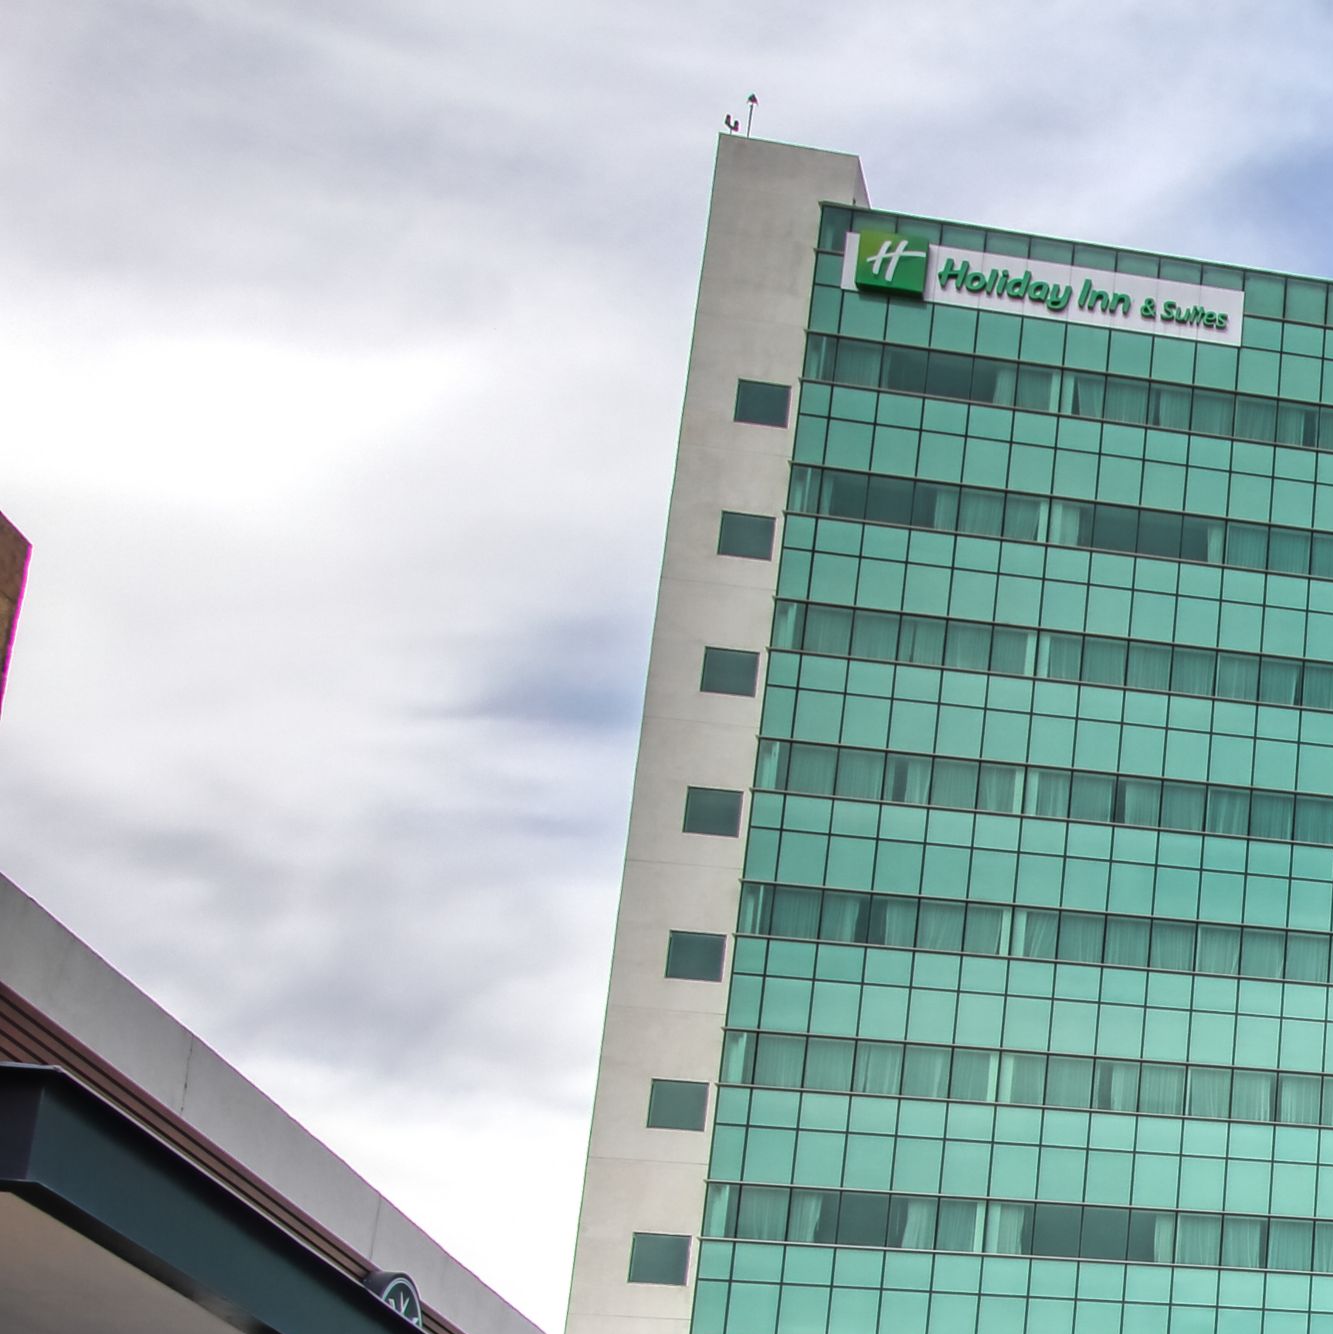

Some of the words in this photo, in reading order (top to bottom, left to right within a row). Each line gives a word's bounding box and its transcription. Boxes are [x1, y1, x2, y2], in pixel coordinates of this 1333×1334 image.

[937, 257, 1073, 311] Holiday
[1078, 279, 1131, 316] Inn
[1139, 298, 1156, 318] &
[1160, 300, 1229, 329] Suites
